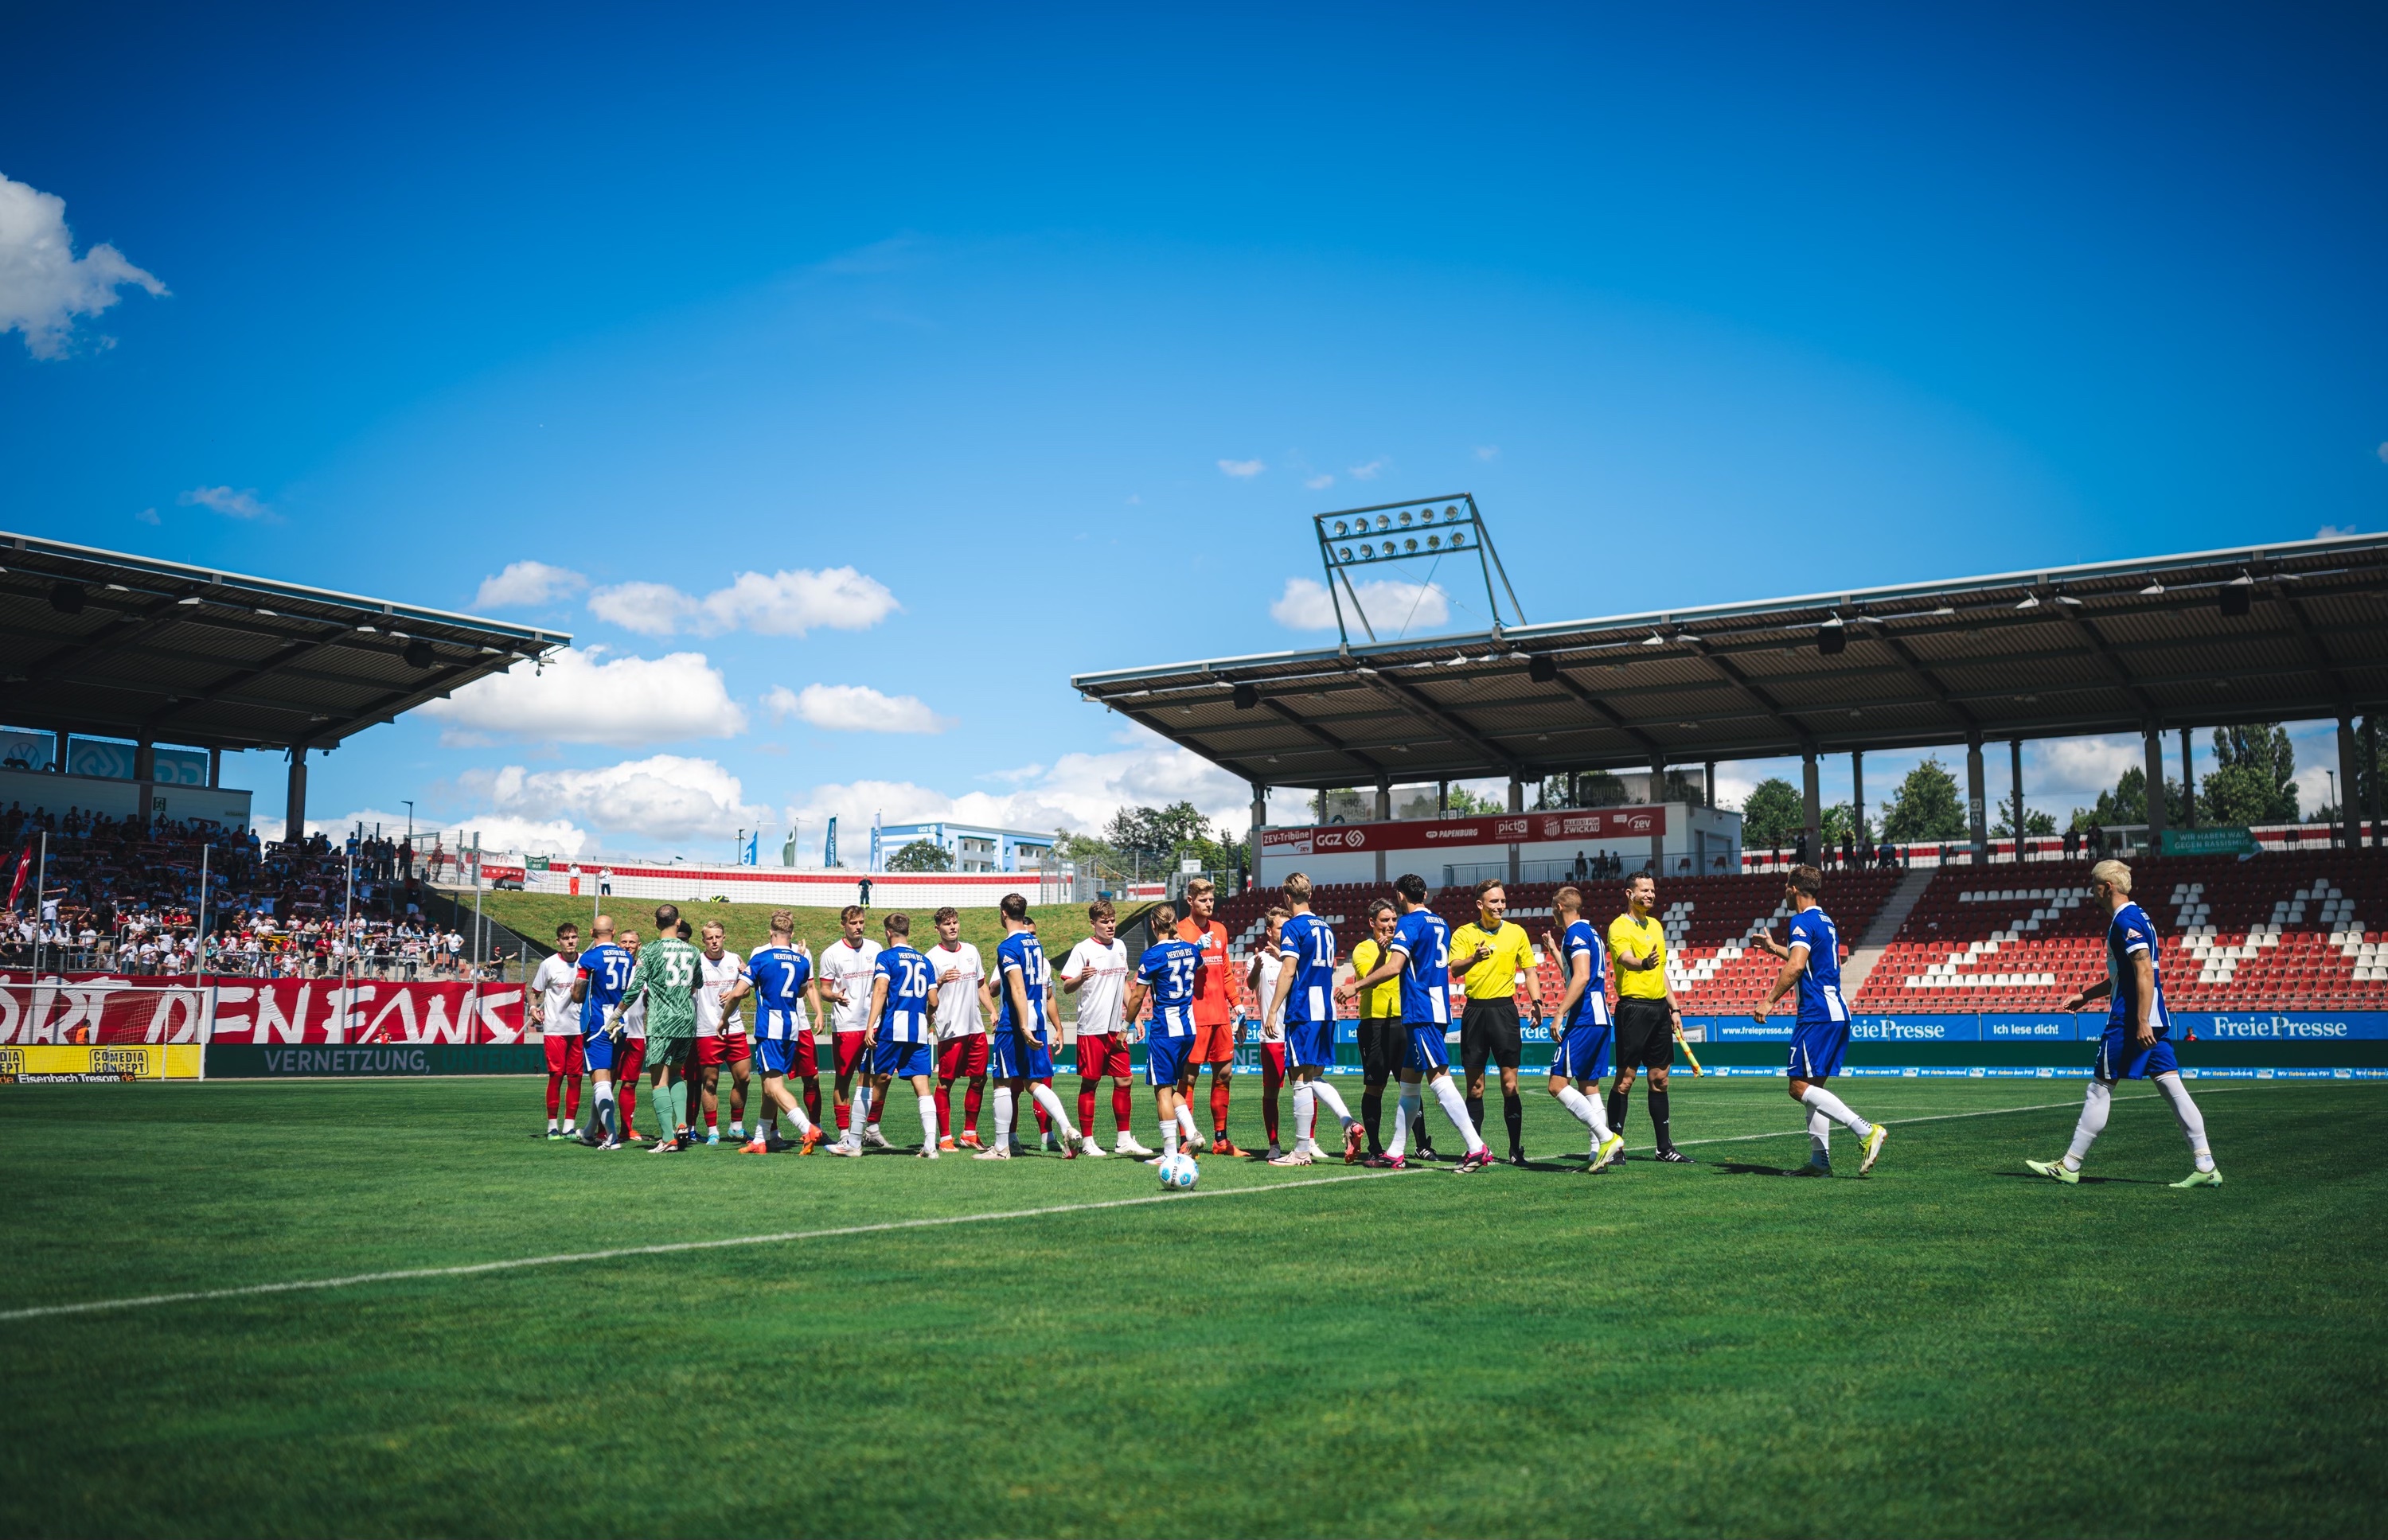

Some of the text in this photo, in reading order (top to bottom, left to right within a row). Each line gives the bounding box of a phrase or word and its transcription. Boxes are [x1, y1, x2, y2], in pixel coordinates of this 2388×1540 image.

[1971, 801, 1980, 809] C2
[1498, 820, 1526, 834] picto
[1563, 825, 1600, 834] ZWICKAU
[1633, 820, 1651, 828] zev
[1263, 830, 1309, 844] ZEV-Tribüne
[1316, 833, 1342, 846] GGZ
[1438, 828, 1478, 838] PAPENBURG
[2174, 841, 2203, 850] GEGEN
[1166, 948, 1194, 960] HERTHA BSC
[1311, 926, 1335, 968] 18
[1434, 926, 1449, 969] 3
[662, 952, 694, 987] 35
[1024, 947, 1044, 985] 41
[603, 956, 630, 991] 37
[780, 961, 796, 998] 2
[898, 959, 927, 999] 26
[1167, 957, 1196, 999] 33
[144, 981, 310, 1044] DEN
[322, 986, 523, 1044] FANS
[1722, 1027, 1793, 1035] www.freiepresse.de
[1993, 1024, 2059, 1035] Ich lese dich!
[94, 1051, 144, 1062] COMEDIA
[264, 1050, 431, 1074] VERNETZUNG,
[1790, 1047, 1797, 1064] 7
[94, 1062, 144, 1073] CONCEPT
[18, 1074, 78, 1083] Eisenbach
